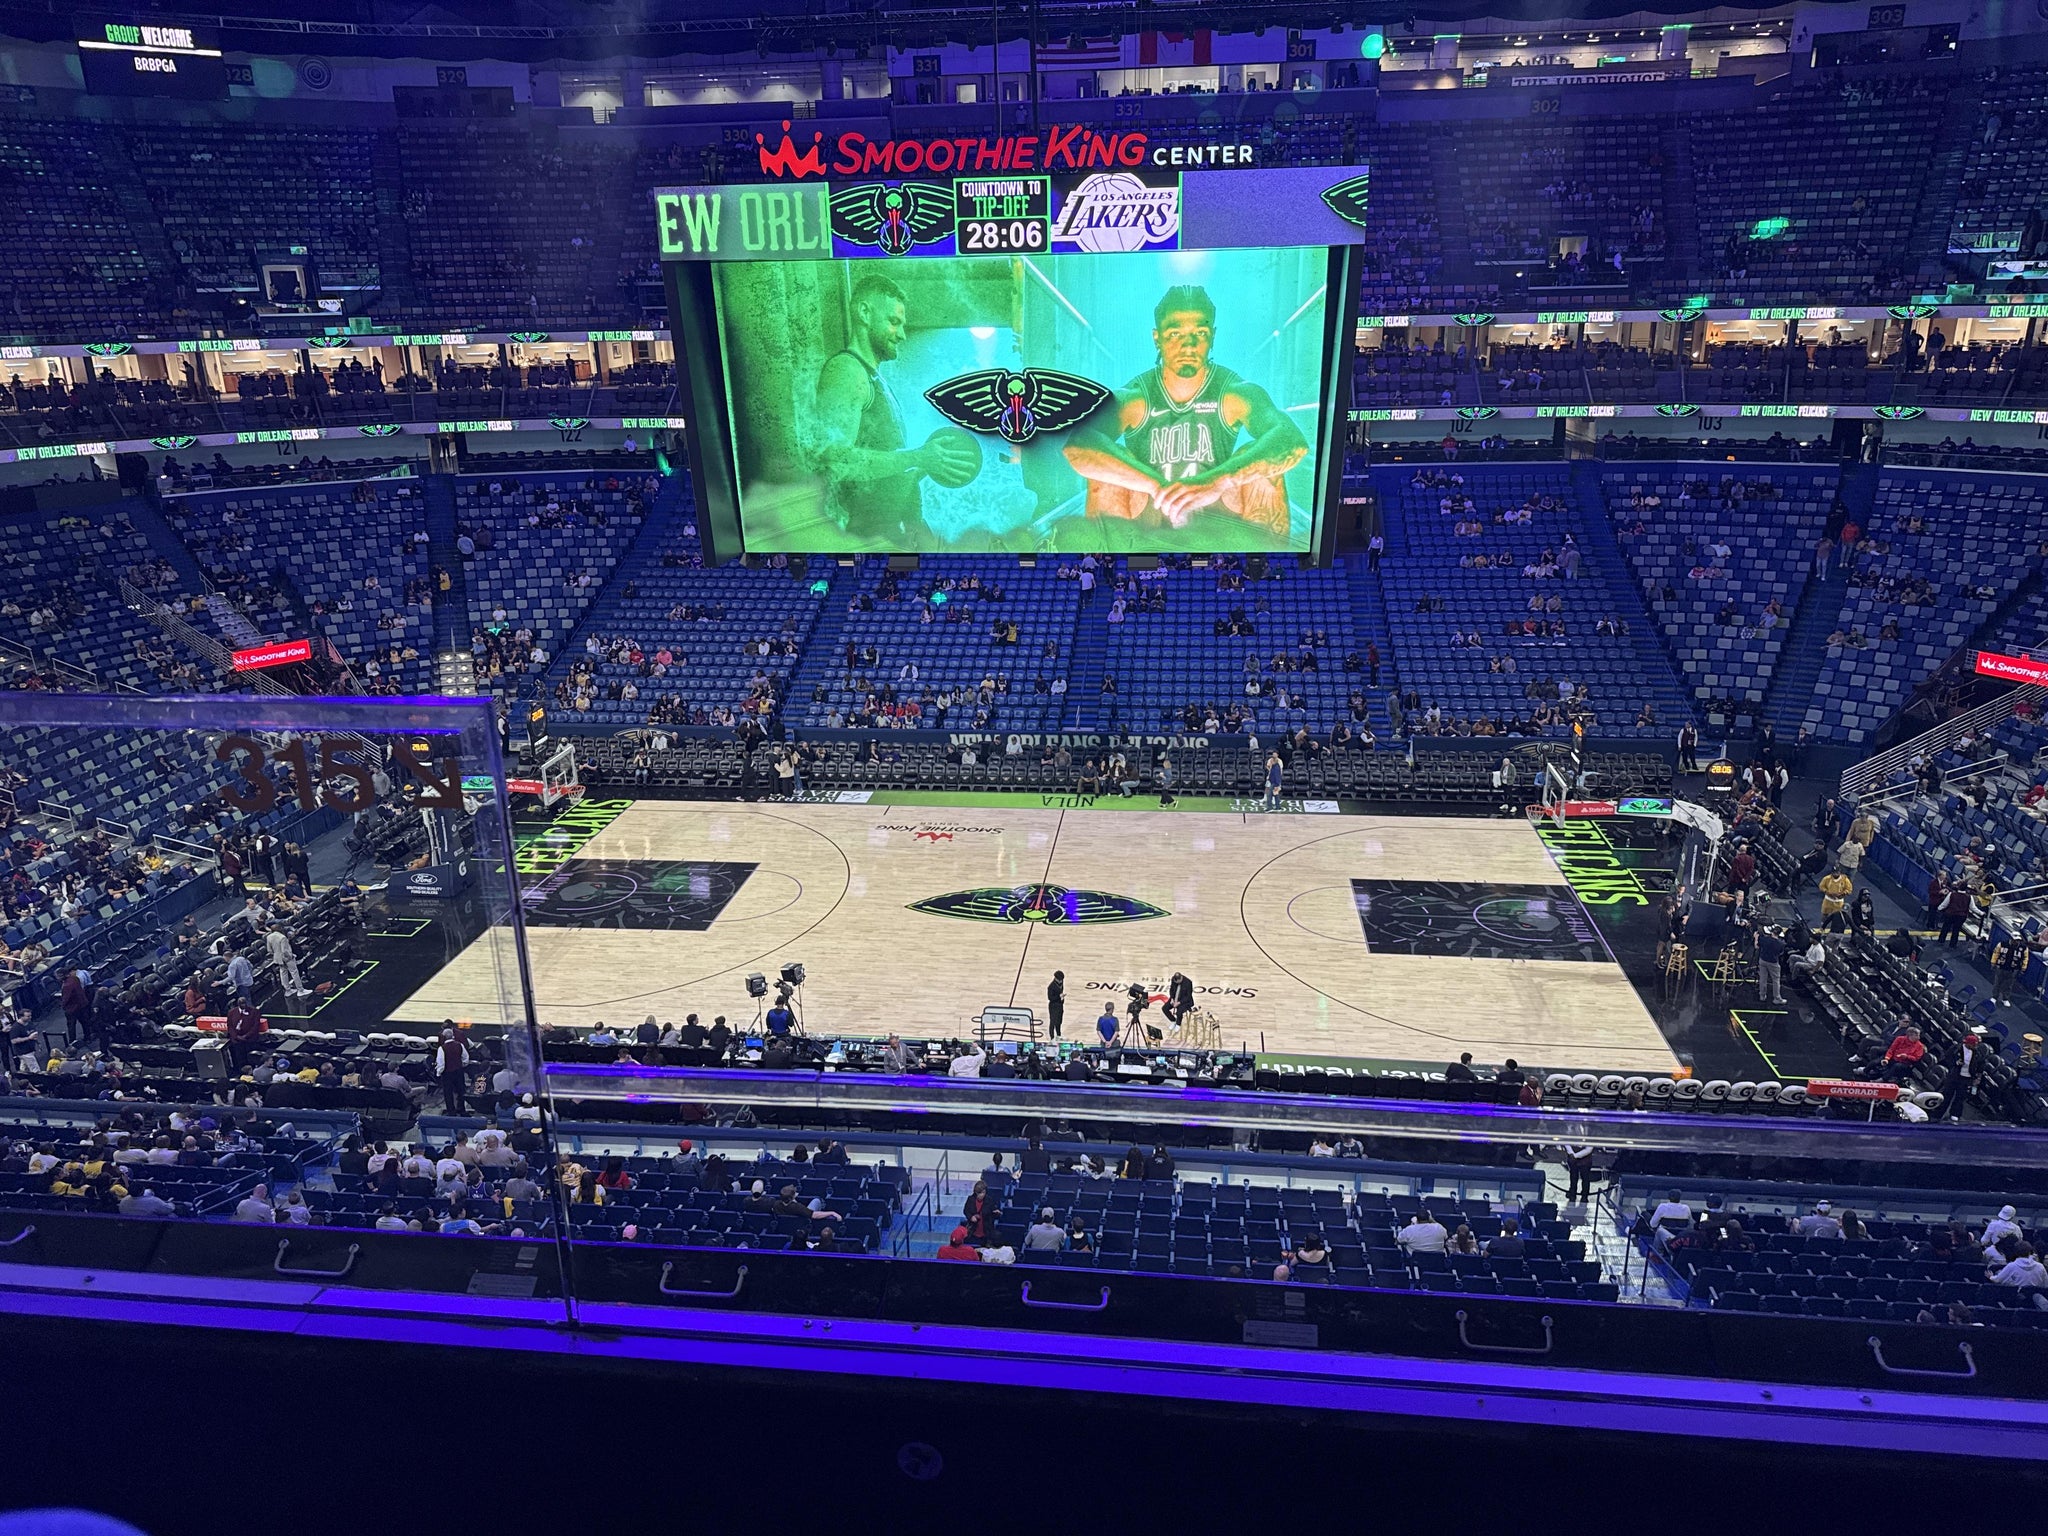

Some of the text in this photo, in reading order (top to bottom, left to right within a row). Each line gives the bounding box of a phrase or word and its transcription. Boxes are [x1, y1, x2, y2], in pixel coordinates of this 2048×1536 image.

[140, 26, 195, 48] WELCOME
[1288, 43, 1315, 60] 301
[134, 57, 178, 73] BRBPGA
[914, 57, 940, 73] 331
[438, 70, 466, 84] 329
[1115, 102, 1144, 118] 332
[1530, 99, 1561, 114] 302
[833, 132, 1039, 174] SMOOTHIE
[1153, 145, 1254, 167] CENTER
[961, 180, 1041, 198] COUNTDOWN TO
[1093, 191, 1174, 202] LOS ANGELES
[974, 196, 1030, 217] TIP-OFF
[1054, 194, 1177, 238] LAKERS
[966, 220, 1043, 249] 28:06
[1538, 312, 1613, 323] NEW ORLEANS PELICANS
[1750, 308, 1836, 319] NEW ORLEANS PELICANS
[1990, 306, 2010, 317] NEW
[1357, 315, 1409, 327] RLEANS PELICANS
[393, 334, 467, 345] NEW ORLEANS PELICANS
[589, 331, 654, 342] NEW ORLEANS PELICANS
[179, 339, 260, 352] NEW ORLEANS PELICANS
[2, 347, 33, 358] PELICANS
[1347, 409, 1416, 421] EW ORLEANS PELICANS
[1537, 405, 1614, 417] NEW ORLEANS PELICANS
[1741, 405, 1828, 417] NEW ORLEANS PELICANS
[1970, 410, 1992, 421] NEW
[1993, 410, 2035, 423] ORLEANS
[439, 420, 512, 432] NEW ORLEANS PELICANS
[623, 418, 638, 428] NEW
[639, 418, 667, 428] ORLEANS
[1451, 419, 1473, 433] 102
[238, 428, 319, 443] NEW ORLEANS PELICANS
[561, 430, 582, 442] 122
[277, 441, 299, 456] 121
[1150, 422, 1214, 464] NOLA
[18, 442, 107, 460] NEW ORLEANS PELICANS
[250, 651, 287, 663] SMOOTHIE
[1996, 662, 2041, 678] SMOOTHIE
[217, 737, 376, 812] 315
[1042, 795, 1094, 807] NOLA
[414, 873, 433, 884] Ford
[1554, 1080, 1567, 1090] G
[1579, 1080, 1593, 1090] G
[1607, 1080, 1620, 1091] G
[1631, 1081, 1644, 1092] G
[1657, 1083, 1671, 1094] G
[1684, 1084, 1698, 1094] G
[1713, 1085, 1726, 1096] G
[1740, 1087, 1751, 1097] G
[1764, 1087, 1777, 1097] G
[1791, 1090, 1805, 1100] G
[1829, 1087, 1879, 1096] GATORADE
[1925, 1096, 1939, 1107] G
